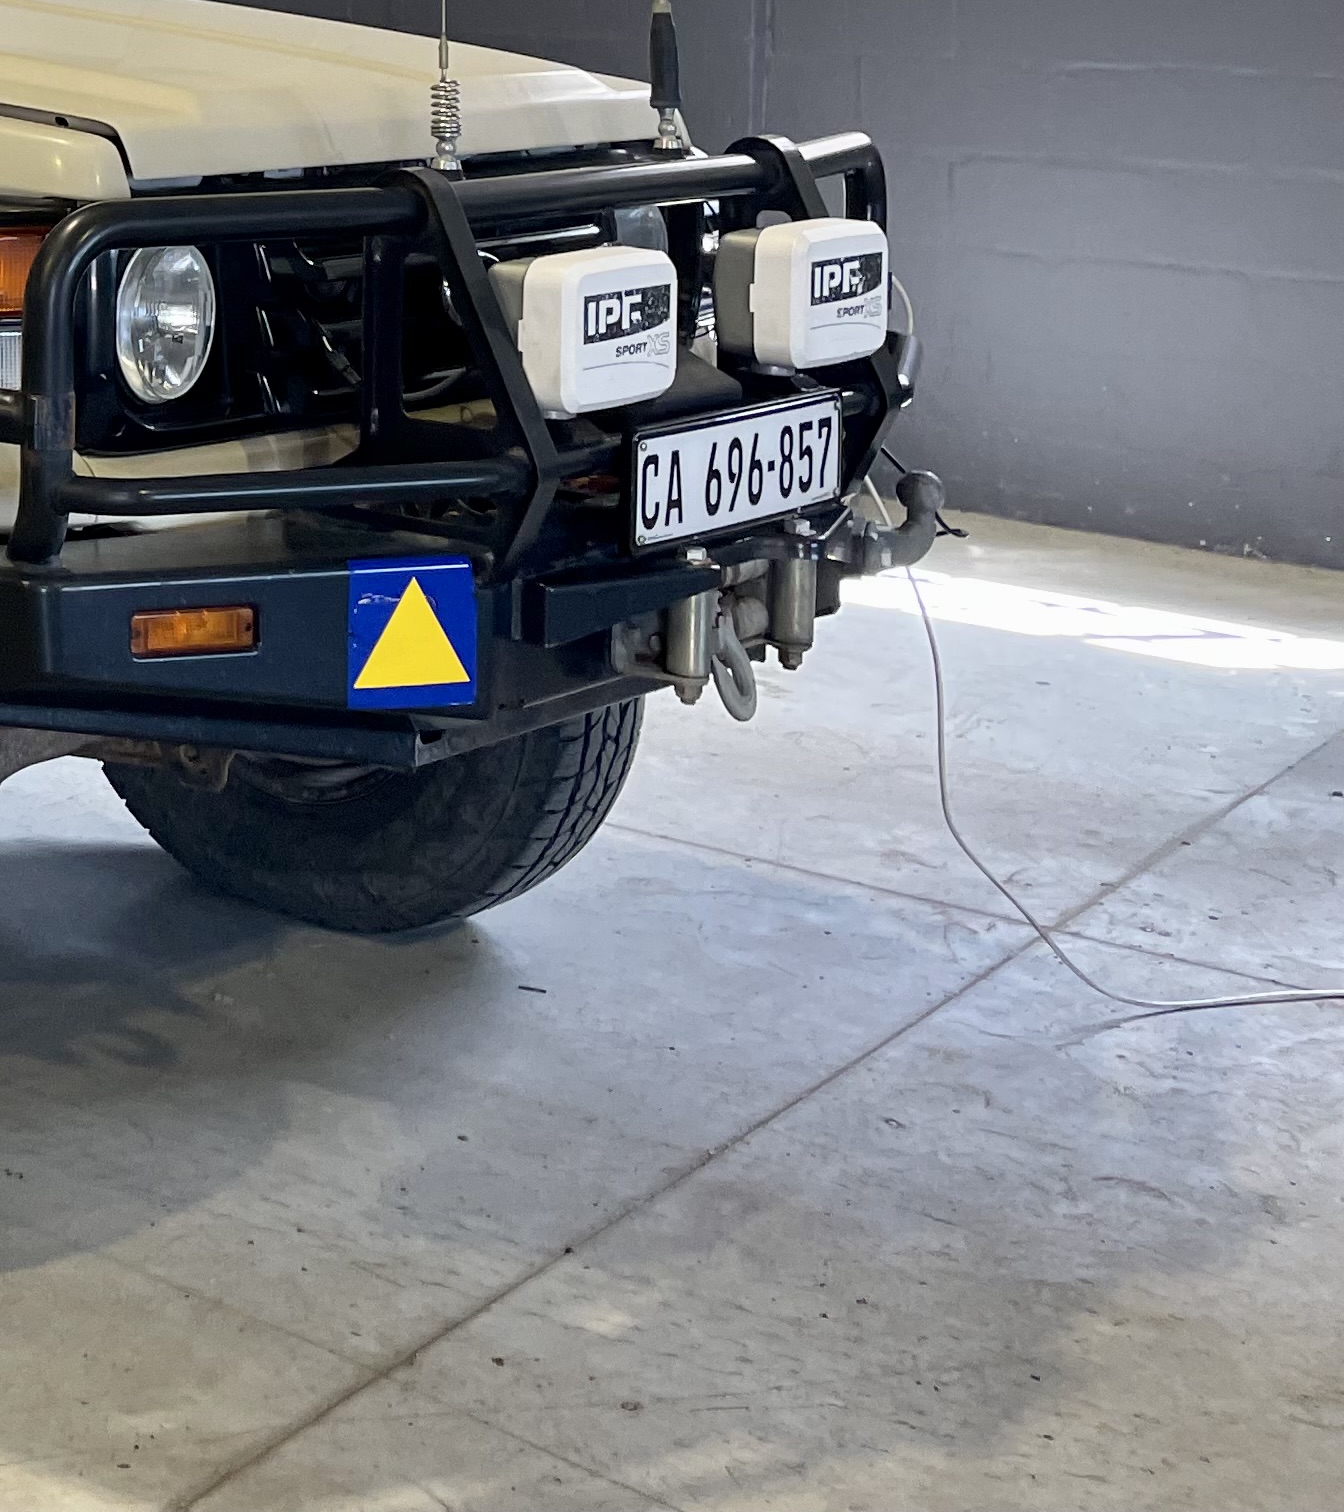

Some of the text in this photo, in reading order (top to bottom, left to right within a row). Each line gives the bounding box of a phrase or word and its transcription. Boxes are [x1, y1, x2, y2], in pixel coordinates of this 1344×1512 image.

[814, 259, 861, 299] IPF
[586, 292, 643, 337] IPF
[836, 304, 865, 319] SPORT
[615, 341, 648, 359] SPORT
[640, 417, 833, 531] CA 696-857
